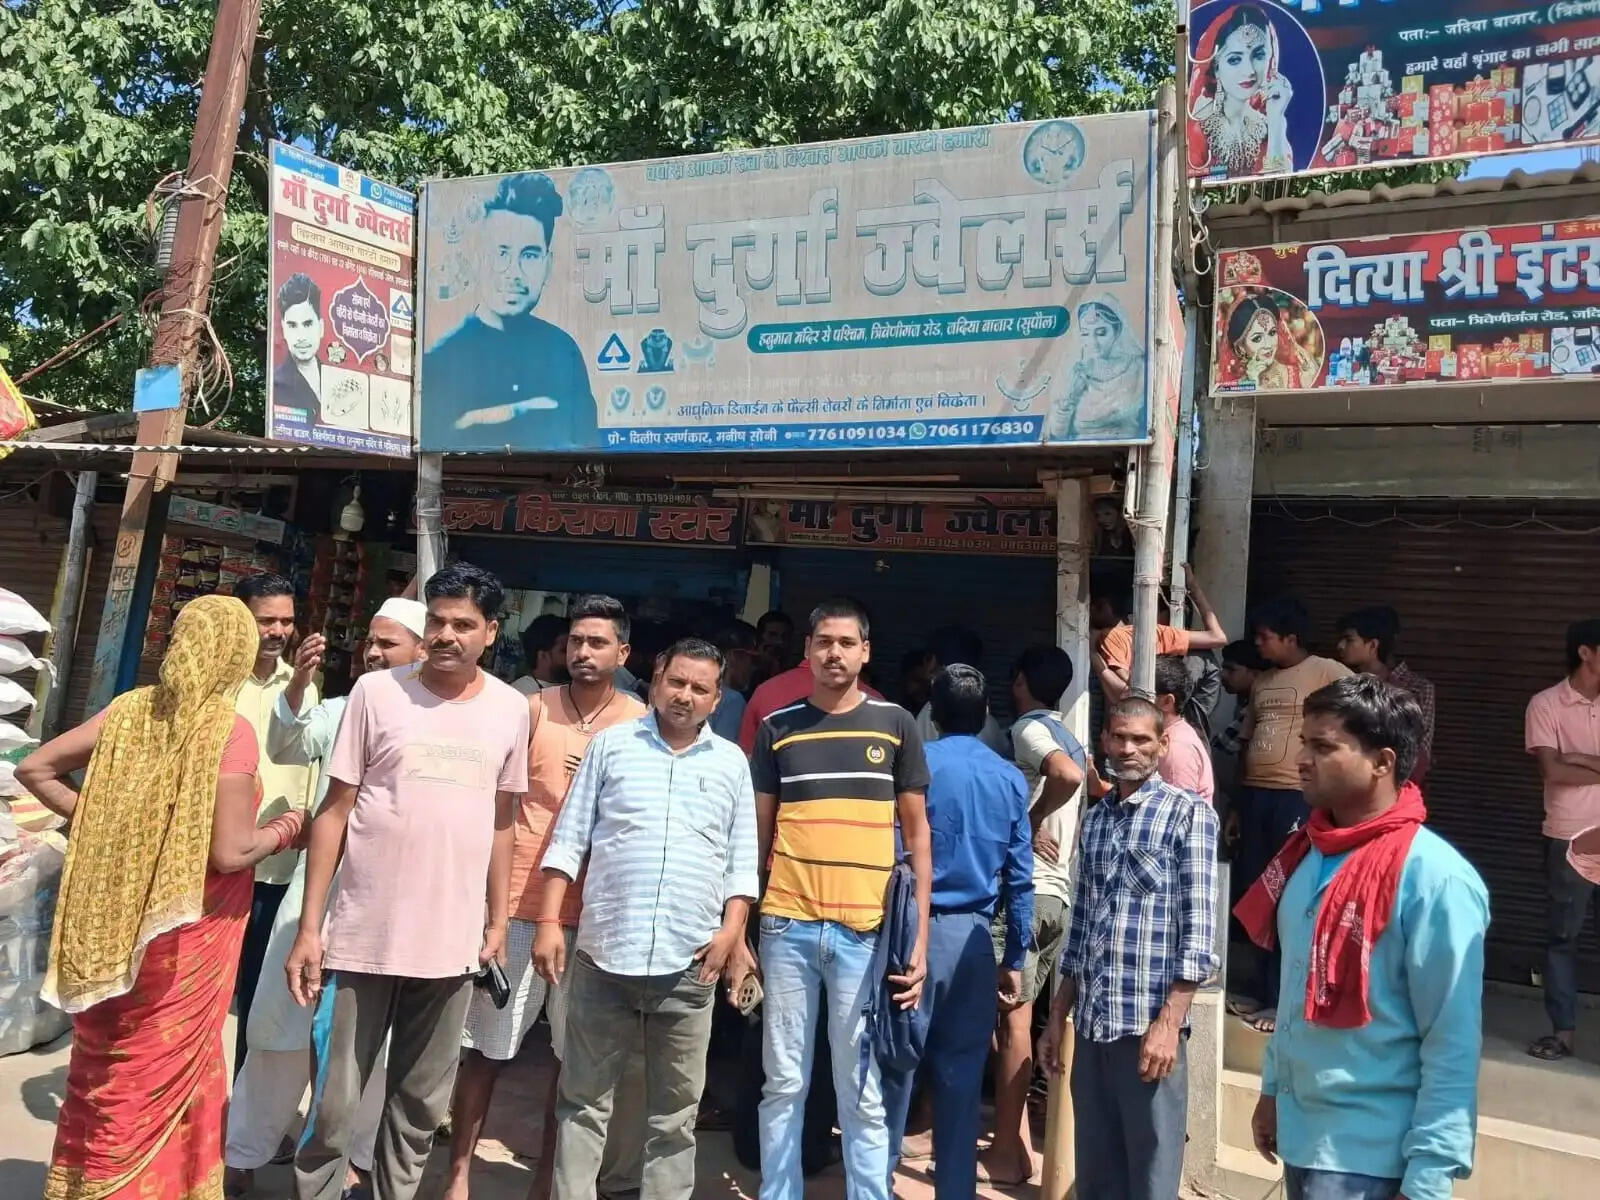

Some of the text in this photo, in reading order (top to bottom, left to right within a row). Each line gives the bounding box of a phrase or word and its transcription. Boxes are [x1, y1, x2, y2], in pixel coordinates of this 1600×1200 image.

[1405, 56, 1439, 75] हमारे
[1511, 46, 1531, 60] का
[280, 174, 307, 210] माँ
[311, 190, 350, 226] दुर्गा
[353, 202, 411, 246] ज्वेलर्स
[576, 157, 1134, 339] माँ दुर्गा ज्वेलर्स
[1303, 224, 1600, 312] दित्या श्री इंटर
[759, 330, 792, 350] हनुमान
[794, 328, 820, 346] मंदिर
[821, 326, 831, 343] से
[677, 400, 726, 420] आधुनिक
[771, 398, 784, 414] के
[856, 395, 869, 411] के
[872, 394, 911, 411] निर्माता
[629, 430, 661, 444] दिलीप
[715, 428, 746, 442] मनीष
[750, 426, 777, 442] सोनी
[808, 424, 906, 441] 7761091034
[928, 421, 1034, 438] 7061176830
[515, 493, 642, 538] किराना
[649, 495, 737, 542] स्टोर
